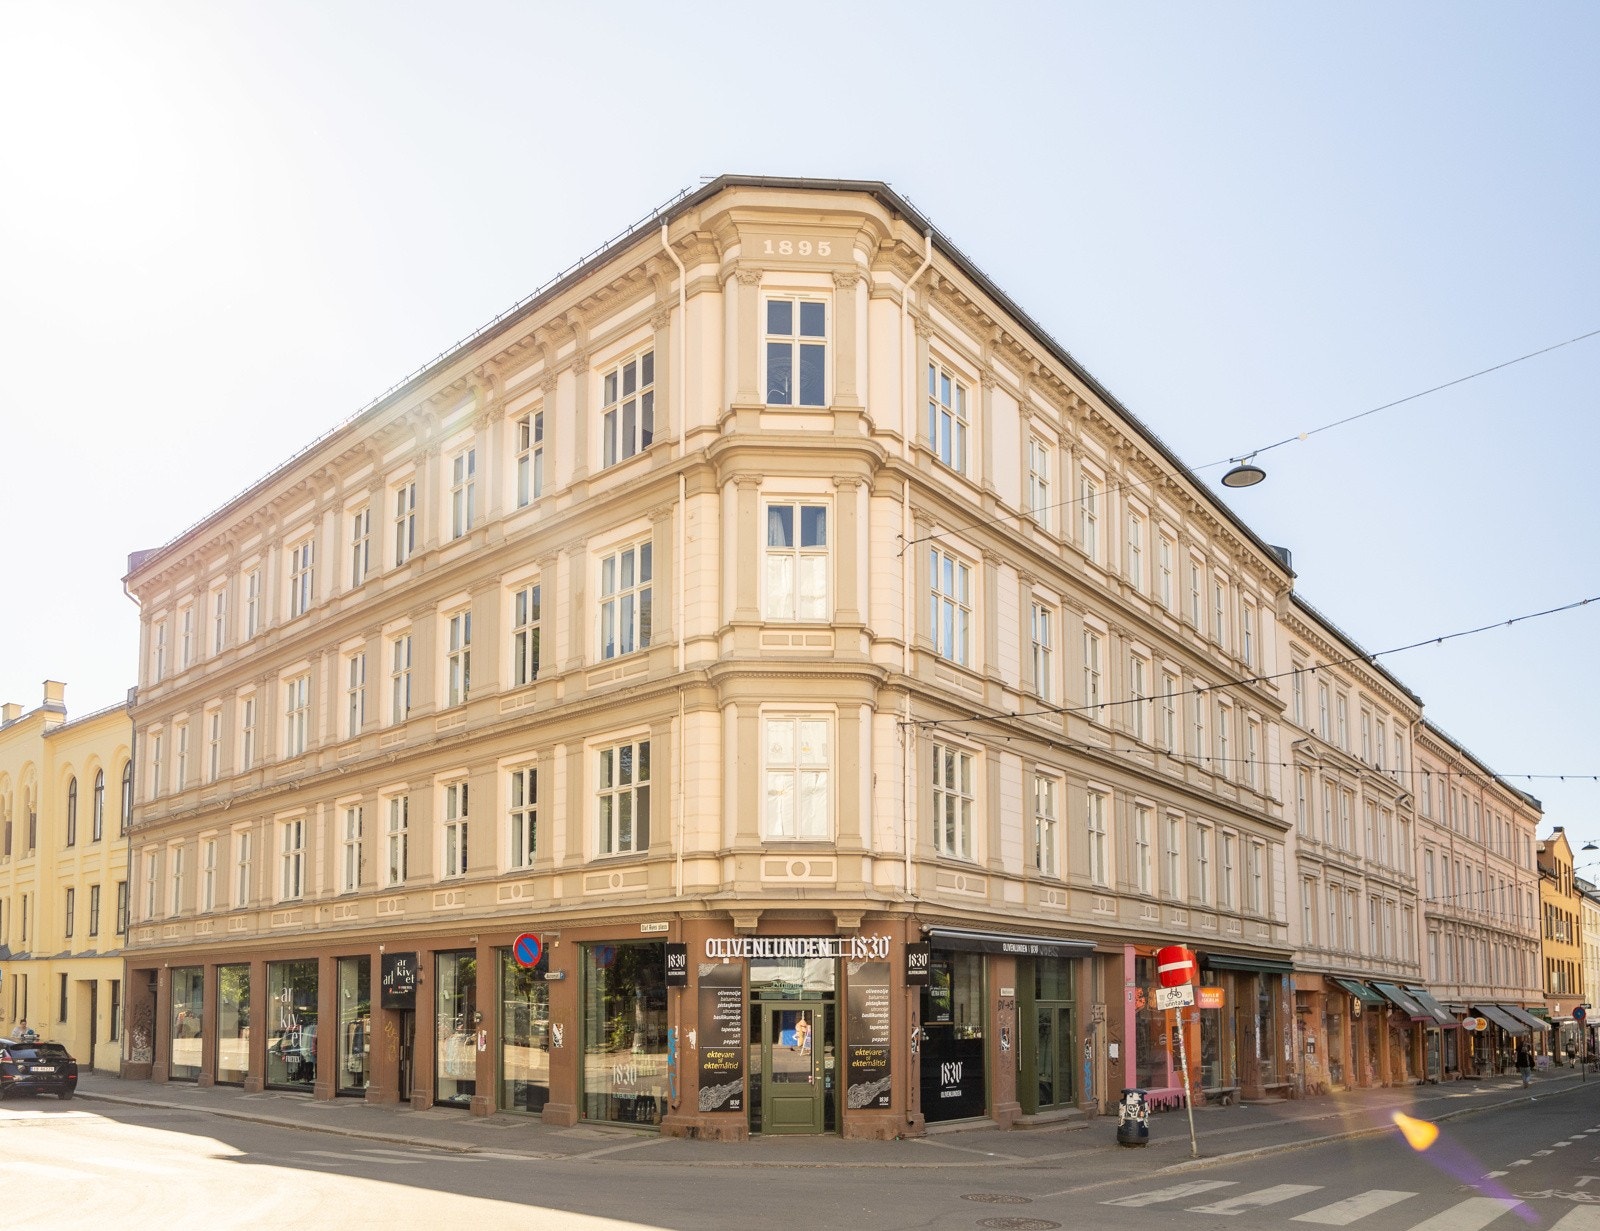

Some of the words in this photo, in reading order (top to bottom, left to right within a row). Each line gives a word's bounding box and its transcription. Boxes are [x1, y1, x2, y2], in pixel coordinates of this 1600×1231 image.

[763, 239, 832, 257] 1895
[705, 938, 829, 958] OLIVENLUNDEN
[851, 935, 891, 960] 1830
[1003, 943, 1028, 953] OLIVENLUNDEN
[397, 959, 407, 967] ar
[667, 954, 686, 968] 1830
[908, 953, 928, 967] 1830
[396, 966, 411, 976] kiv
[405, 974, 415, 984] et
[281, 987, 293, 1003] ar
[855, 1048, 883, 1056] ektevare
[612, 1063, 637, 1086] 1830
[940, 1061, 963, 1086] 1830
